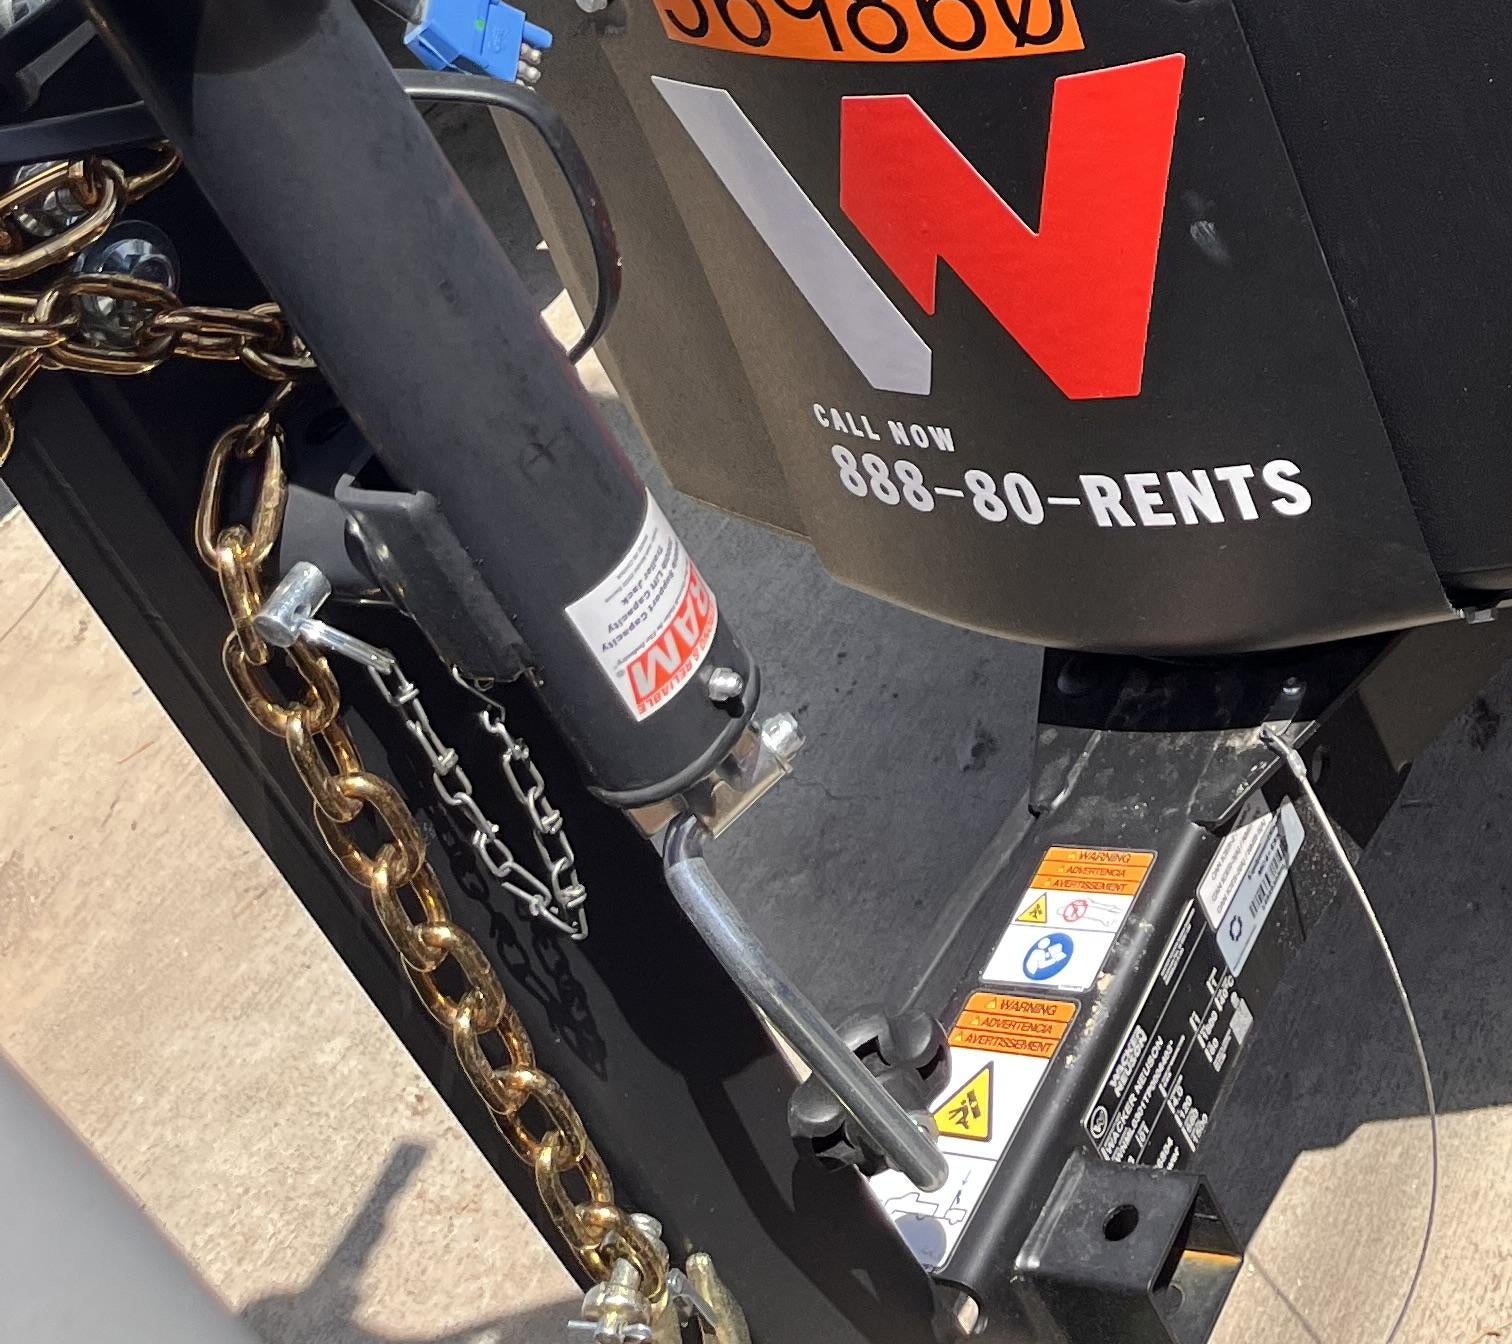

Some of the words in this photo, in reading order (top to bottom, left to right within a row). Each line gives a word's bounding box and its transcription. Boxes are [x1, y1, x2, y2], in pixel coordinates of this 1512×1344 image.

[813, 403, 881, 441] CALL
[888, 420, 956, 453] NOW
[831, 444, 1312, 528] 888-80-RENTS
[643, 545, 664, 580] Trailer
[649, 569, 663, 591] Lift
[620, 579, 644, 606] Jack
[647, 569, 674, 611] Support
[600, 610, 648, 653] Capacity
[605, 589, 652, 634] Capacity
[636, 572, 710, 696] RAM
[636, 658, 694, 715] RELIABLE
[1078, 852, 1131, 864] WARNING
[982, 1017, 1053, 1034] ADVERTENCIA
[1000, 999, 1057, 1016] WARNING
[965, 1033, 1054, 1053] AVERTISSEMENT
[1104, 1092, 1137, 1153] WACKER
[1134, 1035, 1163, 1094] NEUSON
